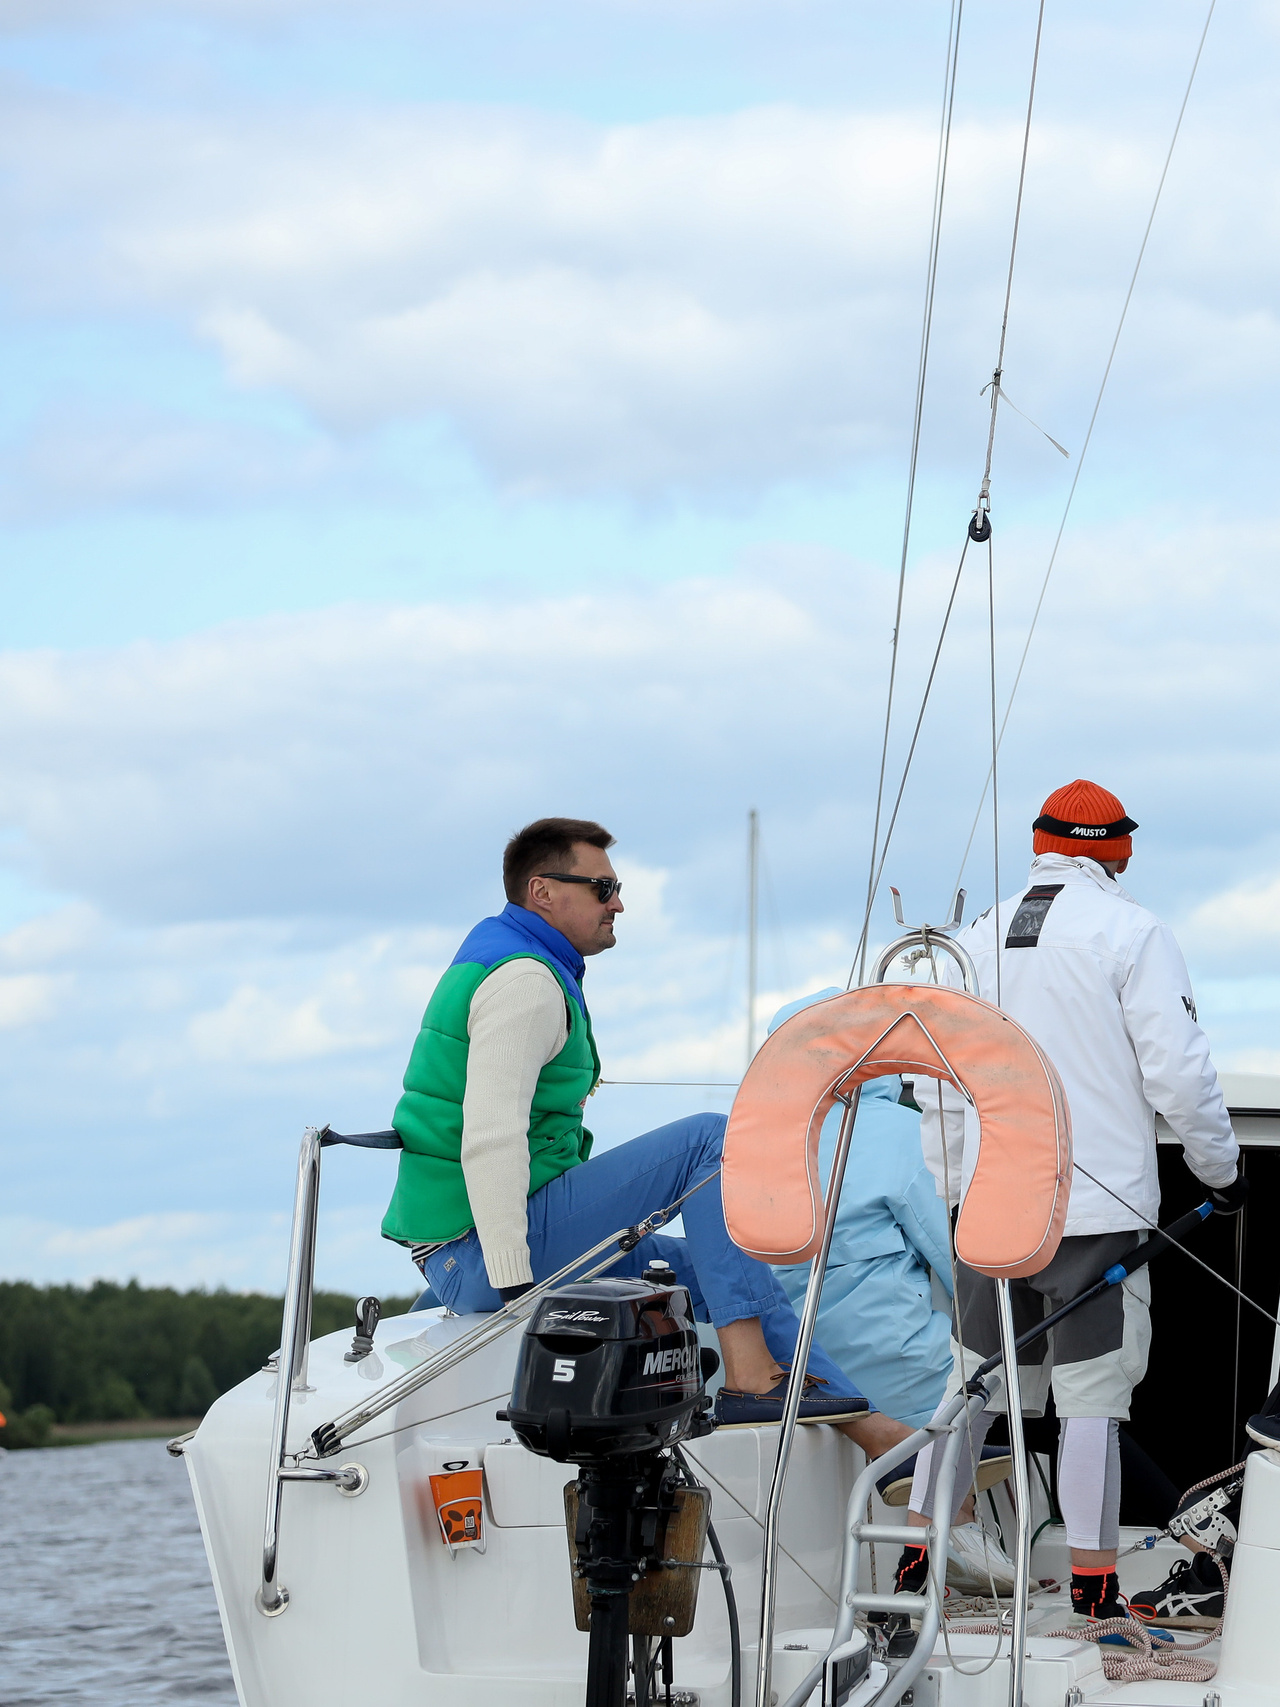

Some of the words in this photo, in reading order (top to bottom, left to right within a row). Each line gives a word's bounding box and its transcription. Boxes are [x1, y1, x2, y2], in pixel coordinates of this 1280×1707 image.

[1070, 826, 1107, 837] MUSTO
[552, 1359, 576, 1382] 5
[643, 1344, 700, 1375] MERCUR
